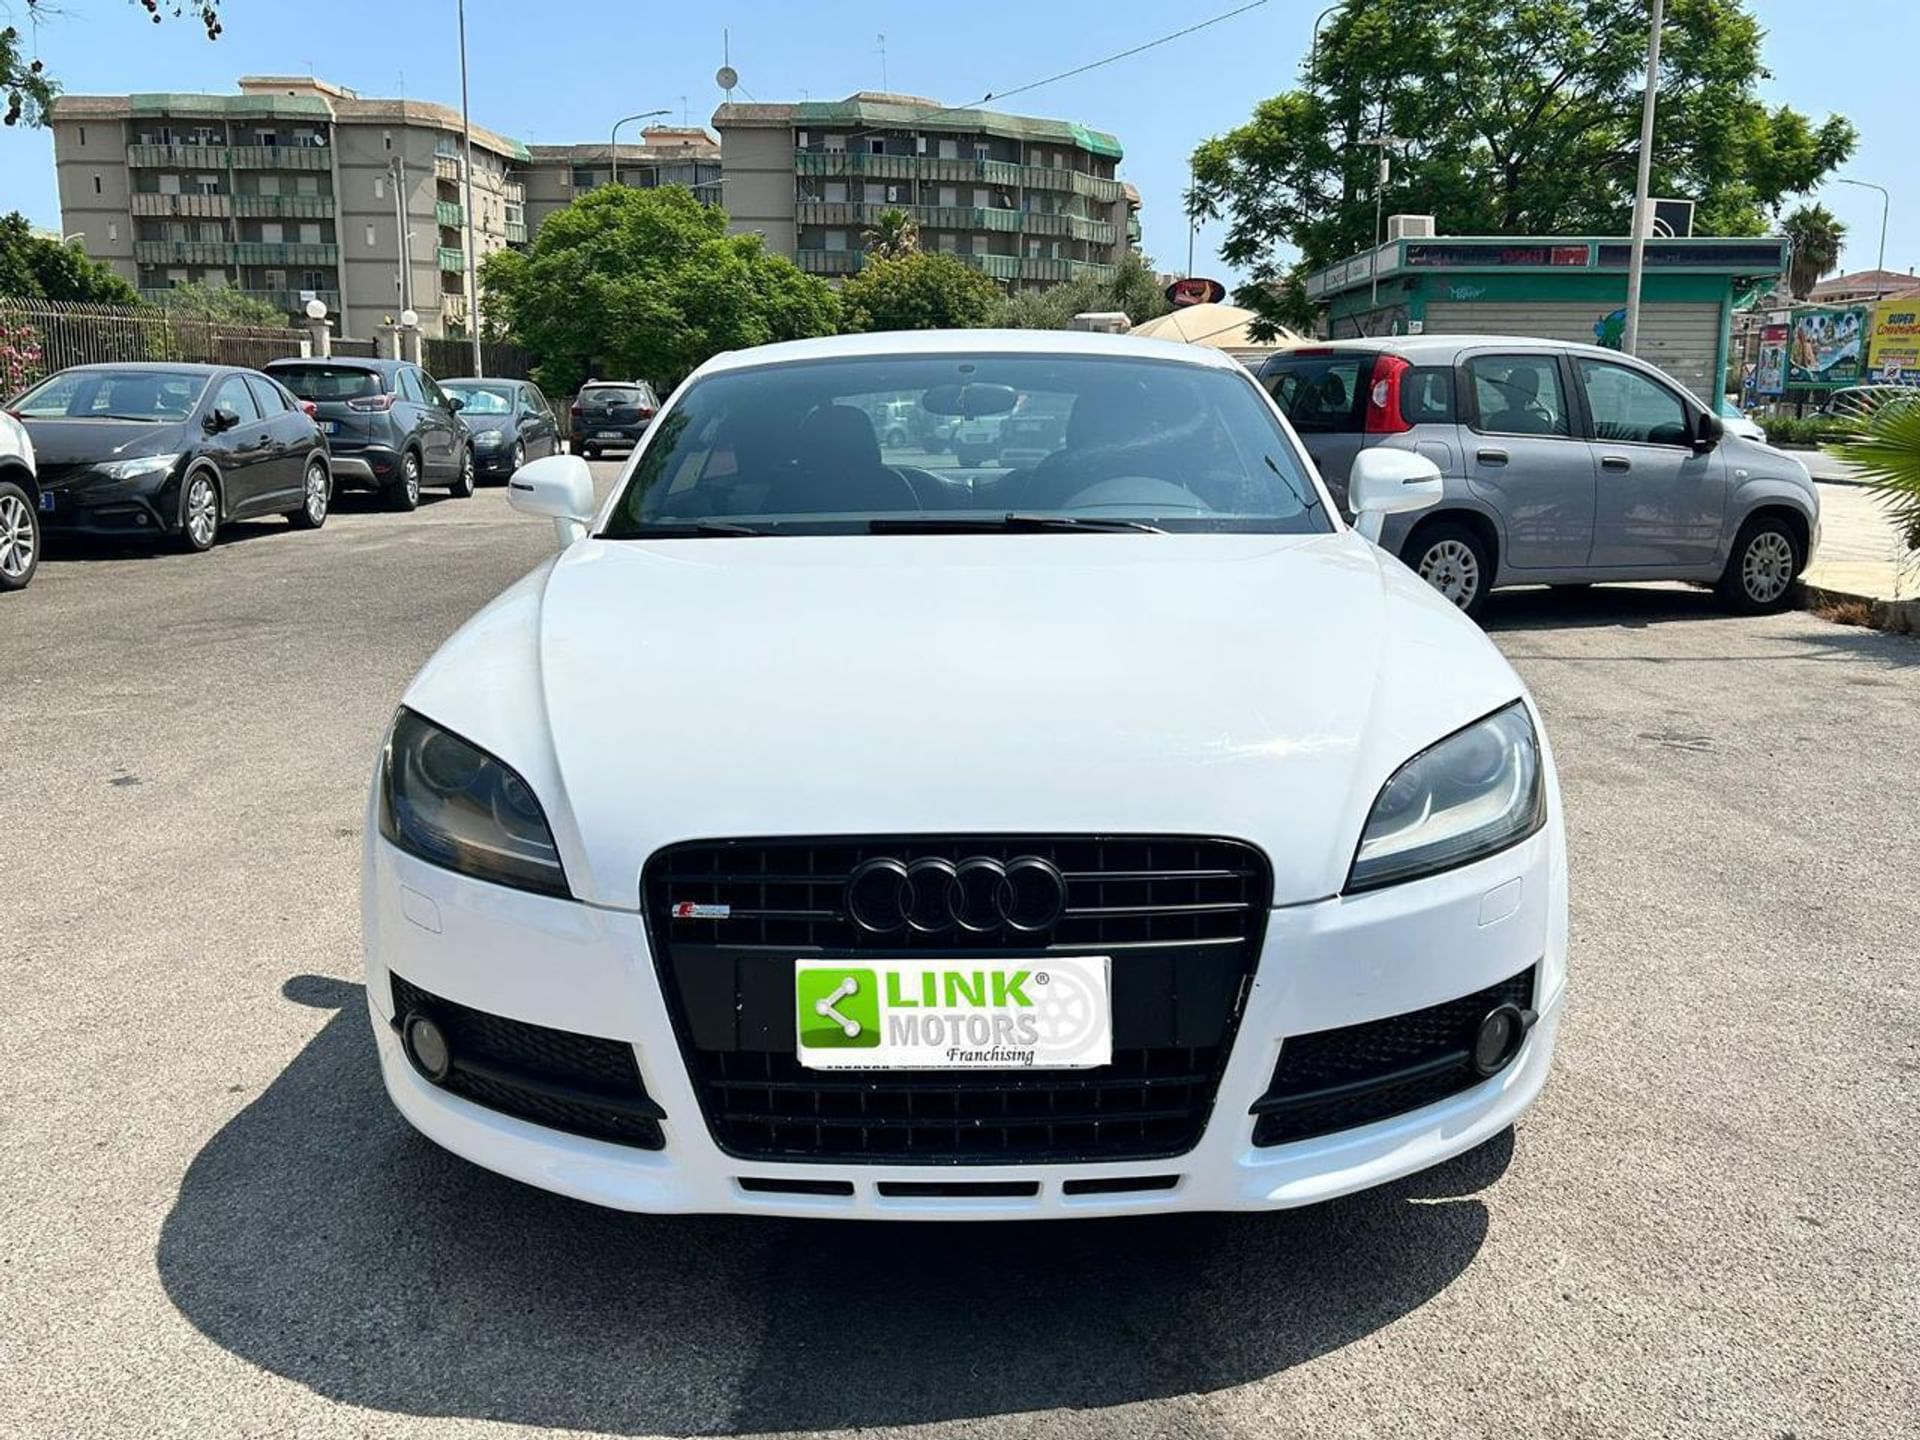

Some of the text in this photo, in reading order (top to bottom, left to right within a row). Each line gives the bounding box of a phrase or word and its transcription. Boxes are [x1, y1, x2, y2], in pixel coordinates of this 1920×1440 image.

[886, 971, 1035, 1008] LINK
[889, 1013, 1039, 1047] MOTORS
[946, 1046, 1035, 1066] Franchising
